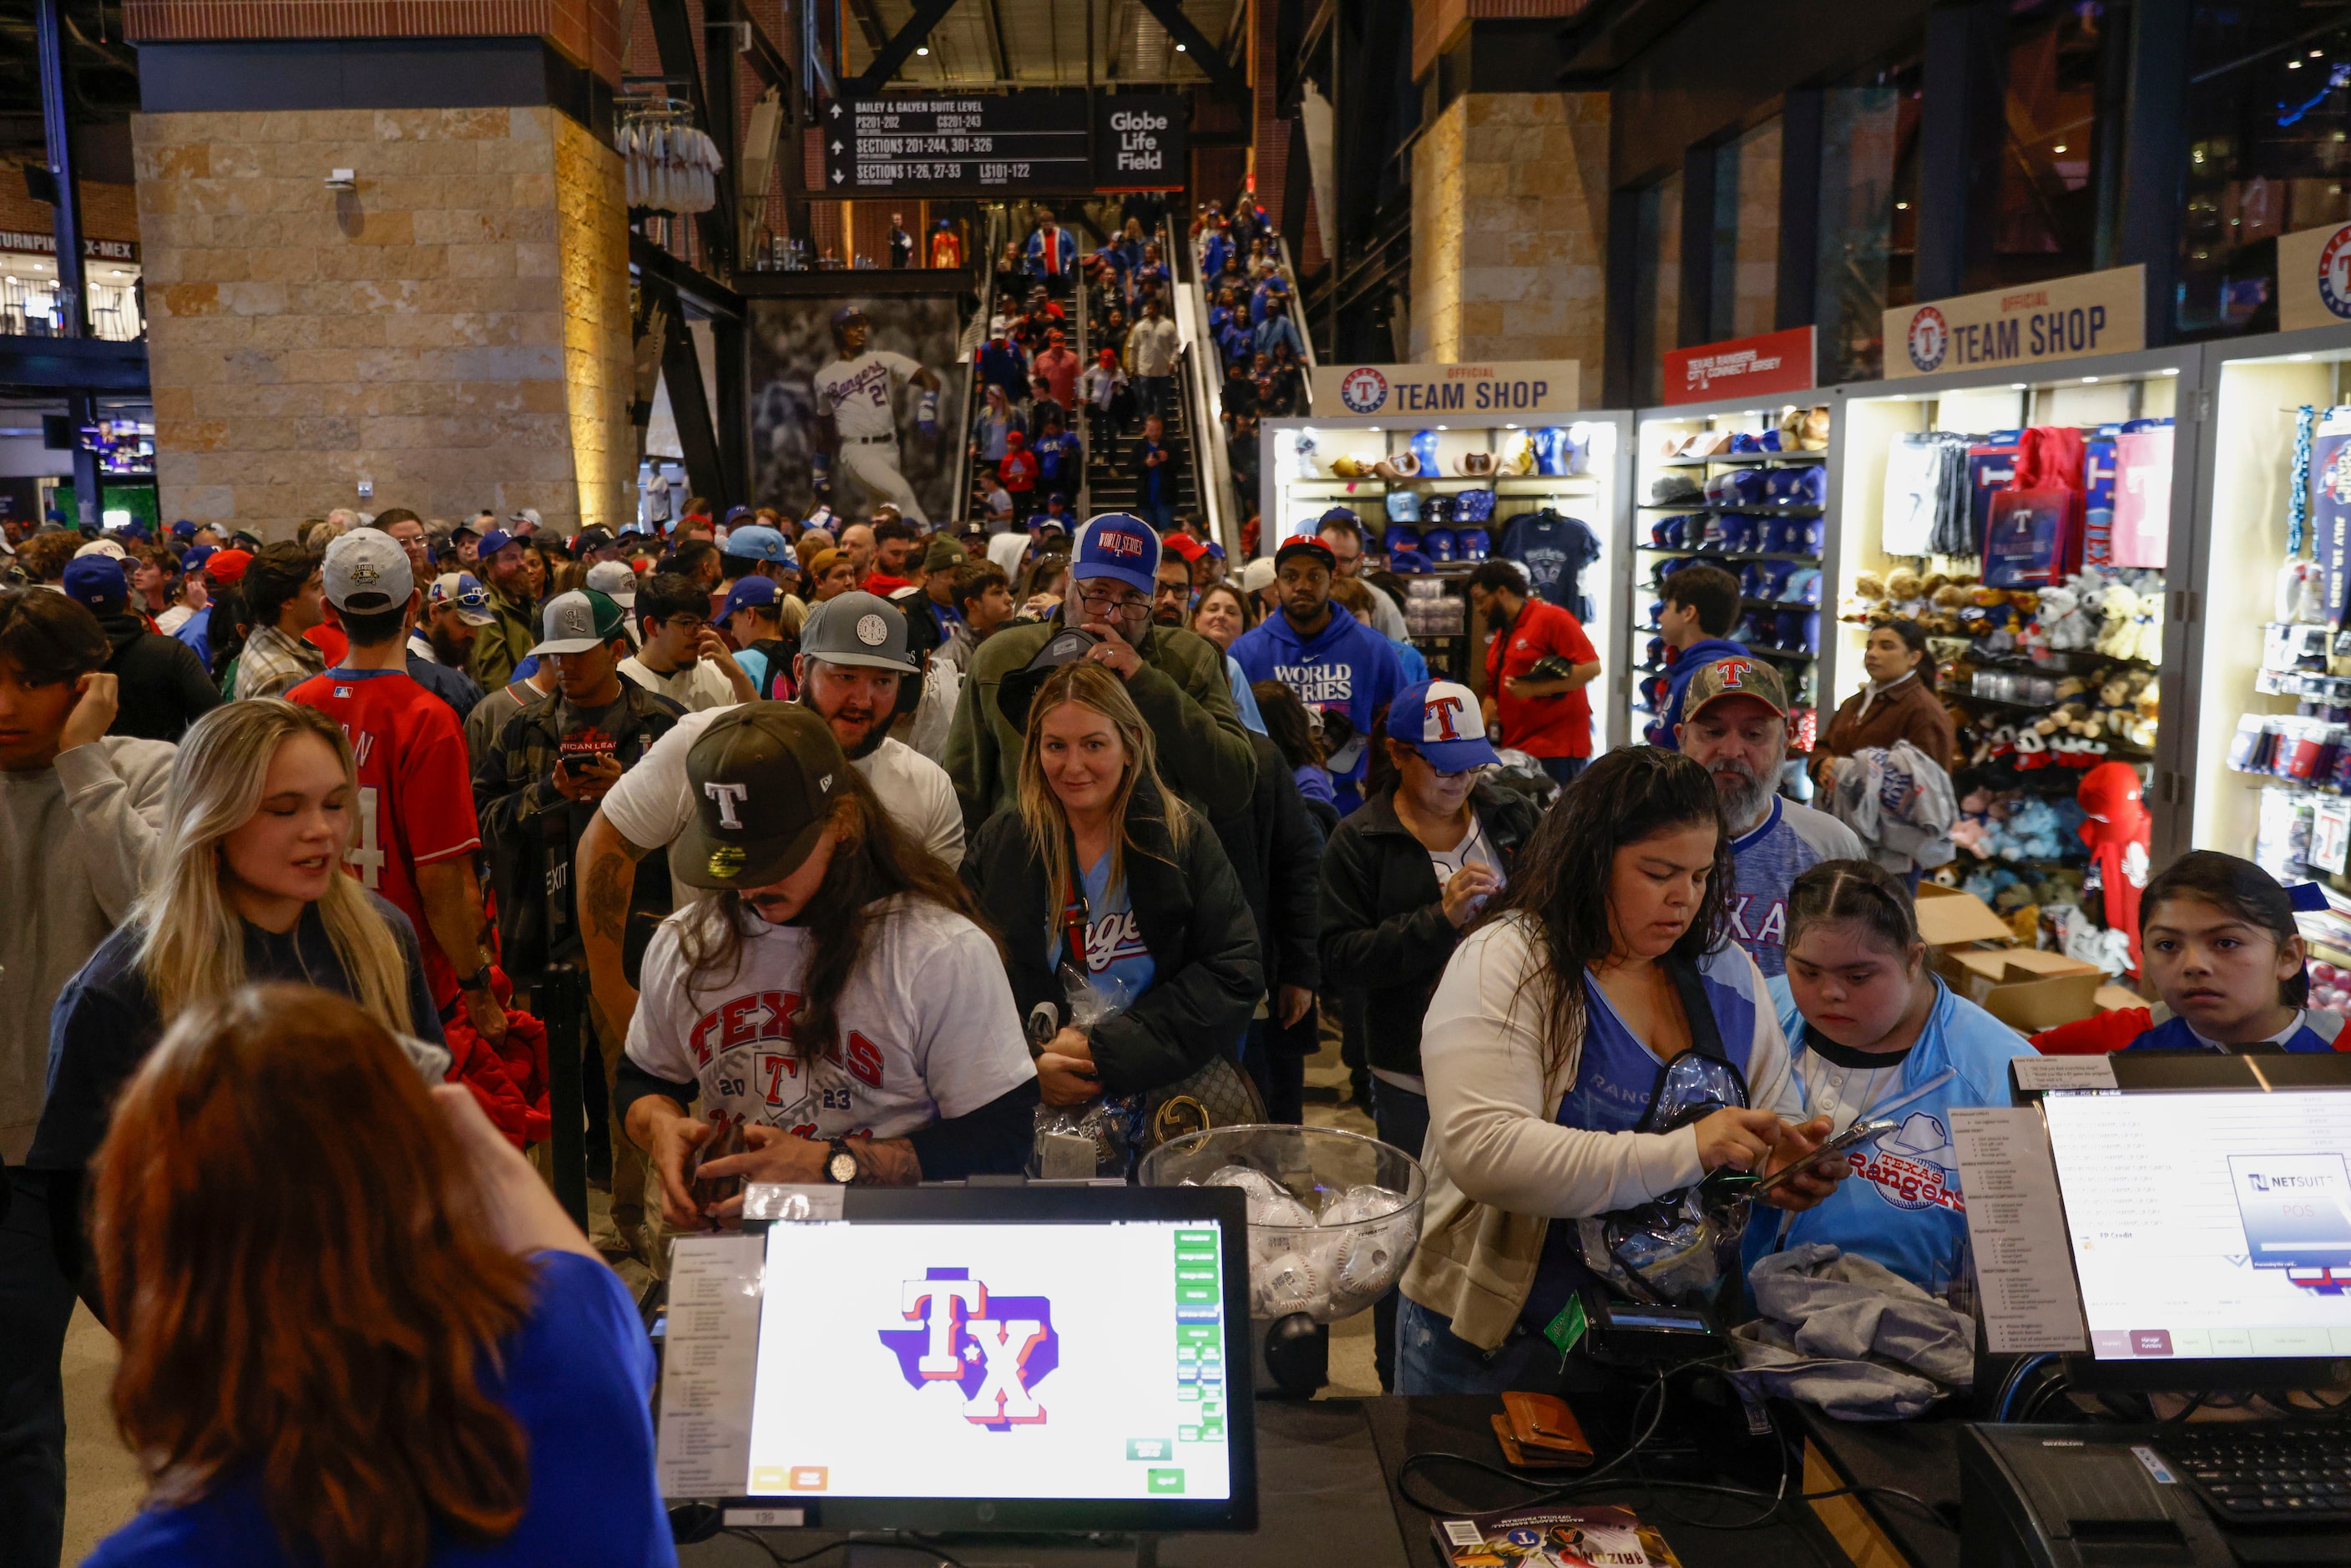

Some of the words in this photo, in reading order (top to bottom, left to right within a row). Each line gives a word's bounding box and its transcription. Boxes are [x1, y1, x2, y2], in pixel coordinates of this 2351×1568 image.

[855, 102, 885, 114] BAILEY
[887, 102, 895, 113] &
[930, 102, 956, 113] SUITE
[958, 102, 983, 113] LEVEL
[856, 116, 900, 129] PS201-202
[937, 115, 982, 128] CS201-243
[1110, 112, 1168, 132] Globe
[857, 138, 903, 154] SECTIONS
[906, 138, 949, 154] 201-244,
[951, 137, 993, 153] 301-326
[1122, 132, 1157, 151] Life
[1117, 151, 1162, 170] Field
[857, 164, 904, 179] SECTIONS
[907, 164, 932, 180] 1-26,
[933, 164, 961, 179] 27-33
[979, 164, 1030, 179] LS101-122
[0, 231, 58, 250] TURNPIK
[85, 239, 132, 259] X-MEX
[2000, 291, 2049, 313] OFFICIAL
[1921, 326, 1934, 355] T
[1953, 317, 2020, 366] TEAM
[2030, 305, 2106, 357] SHOP
[1706, 362, 1747, 378] CONNECT
[1748, 357, 1782, 372] JERSEY
[1716, 349, 1757, 367] RANGERS
[1447, 367, 1495, 379] OFFICIAL
[1356, 381, 1373, 402] T
[1393, 383, 1465, 411] TEAM
[1475, 381, 1549, 410] SHOP
[2013, 508, 2033, 534] T
[1098, 532, 1121, 549] WORLD
[1121, 535, 1144, 556] SERIES
[1298, 534, 1317, 544] T
[2087, 523, 2112, 569] TEX
[1114, 549, 1124, 558] T
[355, 576, 377, 587] CHAMPS
[1273, 663, 1352, 683] WORLD
[1716, 660, 1751, 688] T
[1288, 680, 1352, 701] ERIES
[1424, 696, 1464, 742] T
[560, 742, 593, 751] RICAN
[594, 741, 617, 751] LEA
[704, 781, 749, 830] T
[2319, 816, 2343, 860] T
[546, 861, 568, 896] EXIT
[719, 1078, 746, 1097] 20
[765, 1055, 798, 1109] T
[822, 1088, 852, 1111] 23
[1590, 1072, 1651, 1105] RANG
[1881, 1154, 1944, 1185] TEXAS
[1848, 1151, 1967, 1212] Rangers
[2271, 1176, 2335, 1188] NETSUIT
[2283, 1204, 2315, 1218] POS
[2141, 1337, 2161, 1345] Manager
[1515, 1531, 1536, 1545] T
[1583, 1550, 1644, 1566] ARIZON
